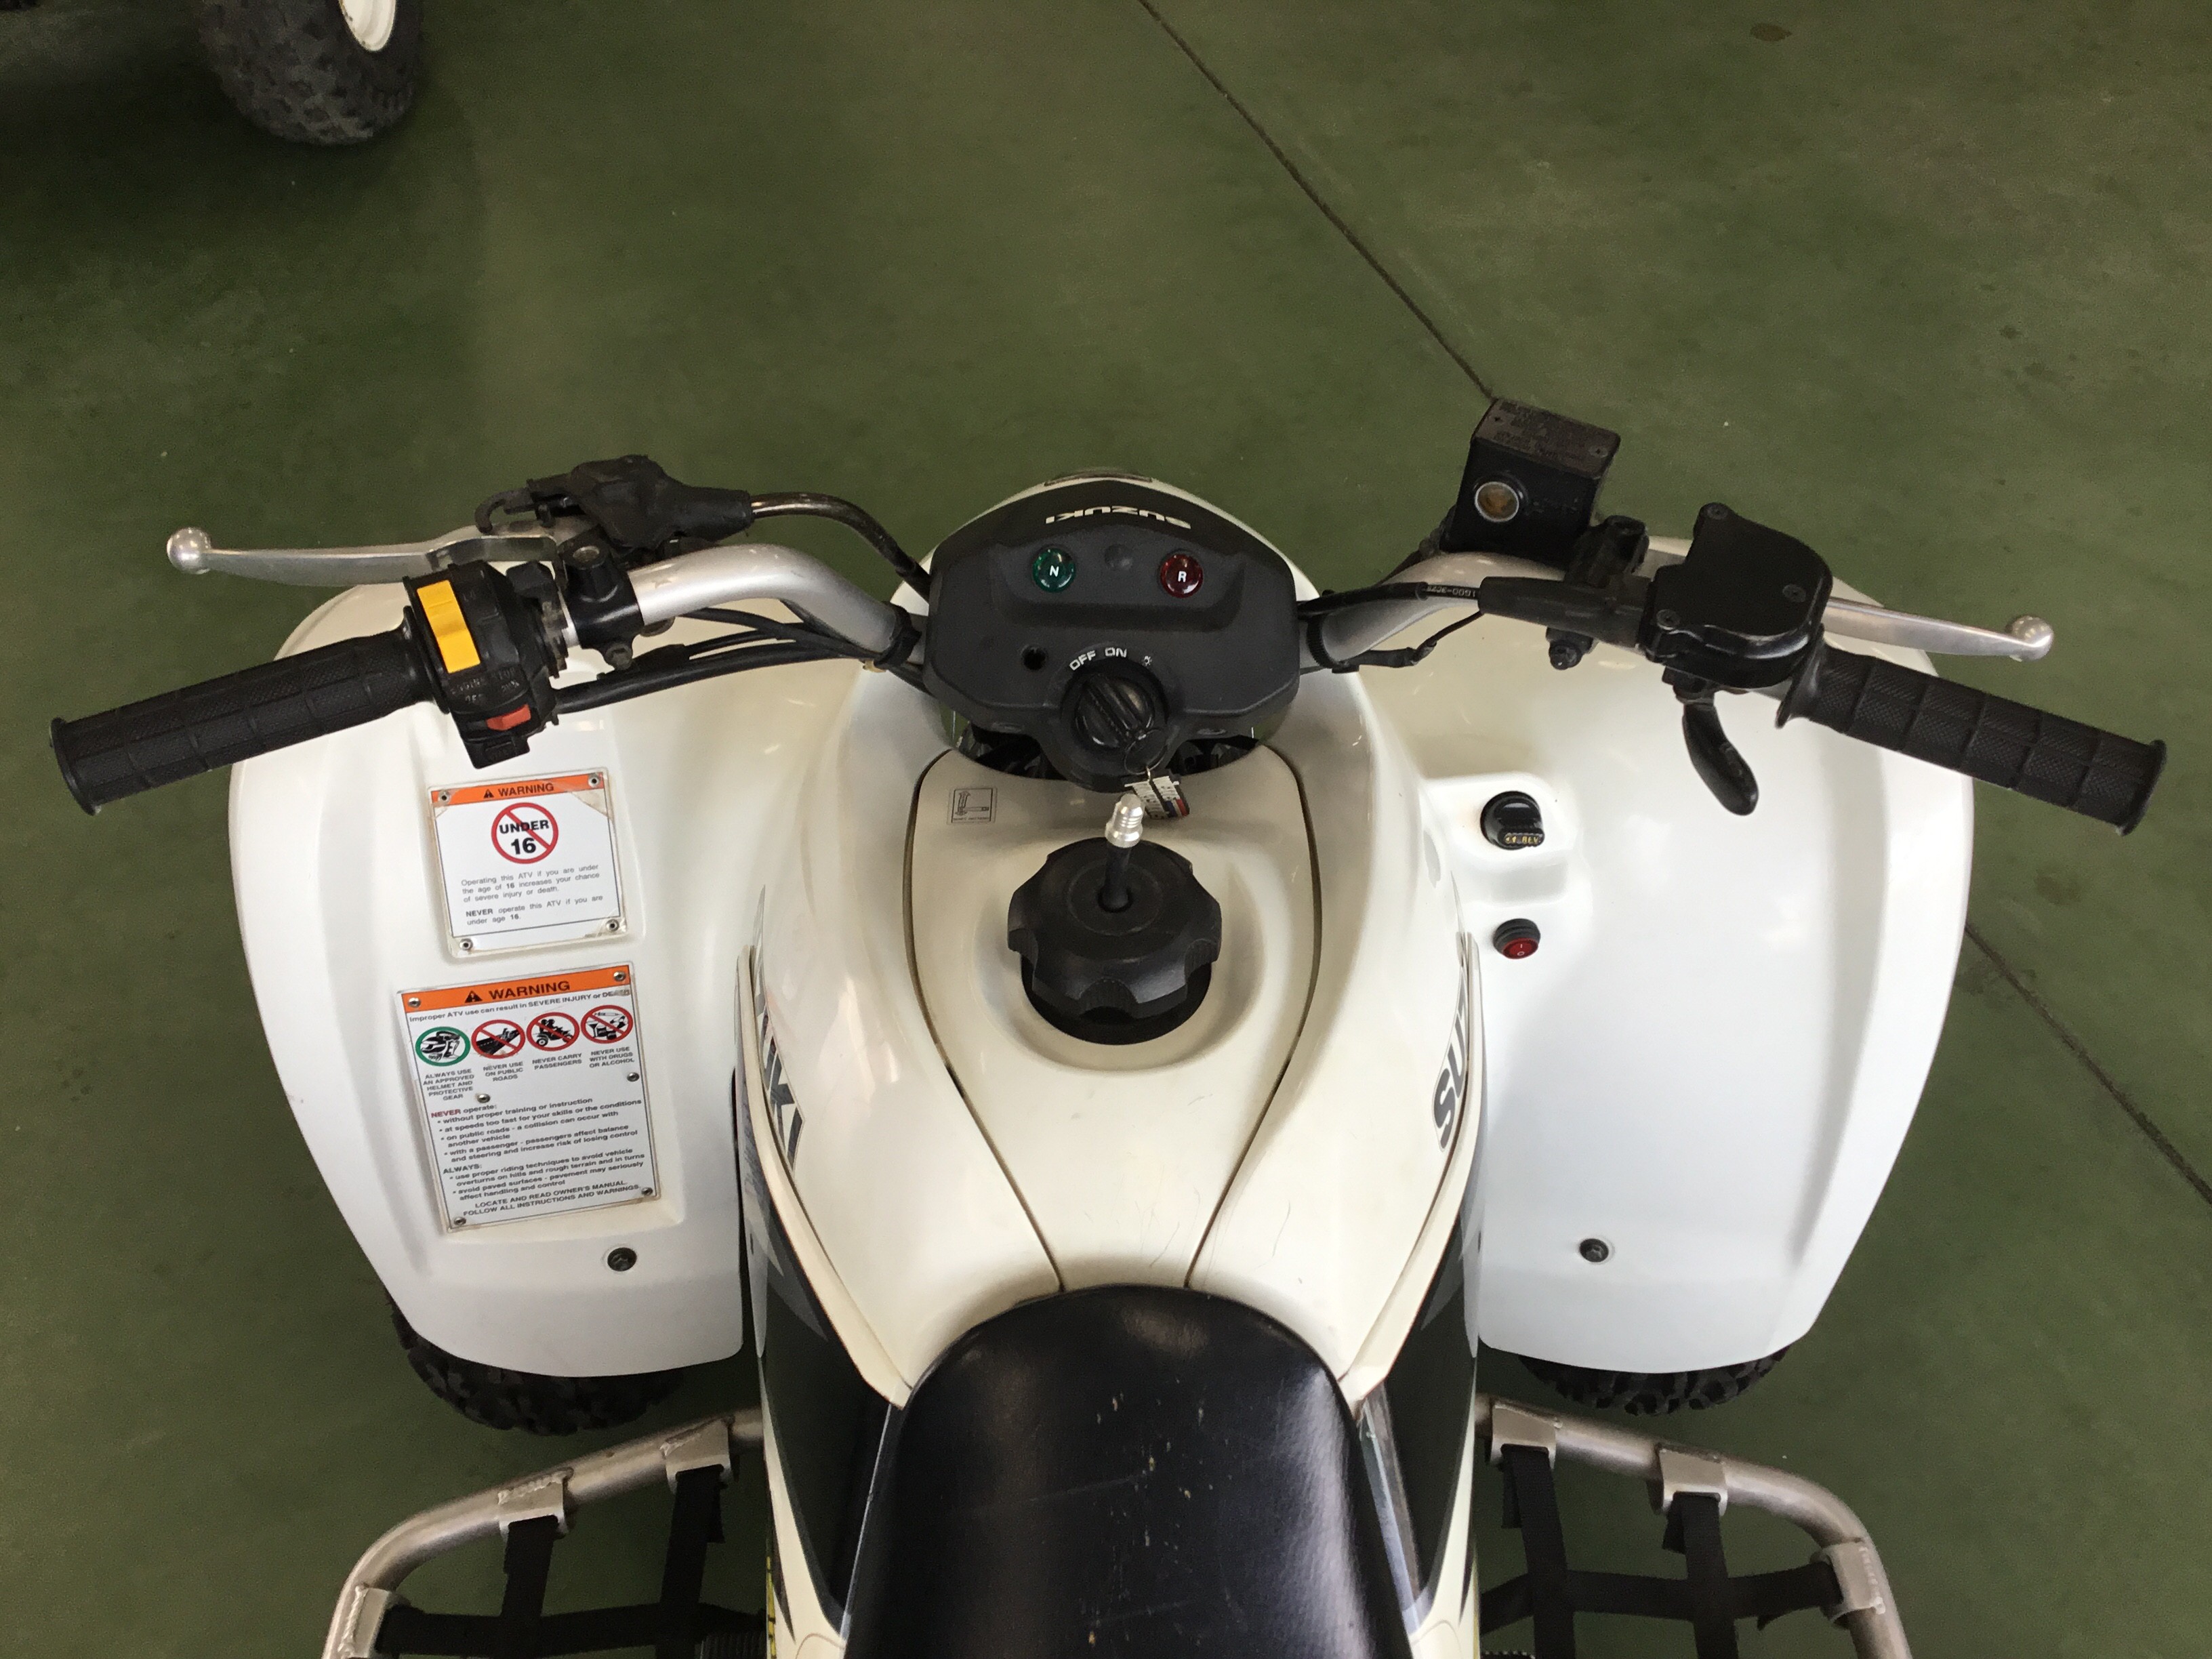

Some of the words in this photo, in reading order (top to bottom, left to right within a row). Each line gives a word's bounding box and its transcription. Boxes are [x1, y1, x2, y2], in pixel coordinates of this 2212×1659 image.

[1050, 565, 1059, 577] N
[1178, 571, 1187, 582] R
[1105, 647, 1127, 658] ON
[1069, 650, 1096, 670] OFF
[498, 783, 554, 797] WARNING
[499, 819, 550, 834] UNDER
[511, 838, 537, 855] 16
[461, 877, 497, 886] Operating
[518, 871, 533, 879] ATV
[545, 869, 559, 878] you
[578, 864, 598, 872] under
[518, 878, 552, 887] increases
[555, 876, 571, 884] your
[575, 872, 600, 880] chance
[502, 890, 522, 899] injury
[466, 908, 493, 917] NEVER
[498, 905, 525, 914] operate
[546, 899, 561, 907] ATV
[489, 981, 570, 1000] WARNING
[409, 1013, 445, 1022] Improper
[528, 998, 560, 1007] SEVERE
[562, 994, 592, 1002] INJURY
[531, 1056, 556, 1064] NEVER
[557, 1052, 582, 1061] CARRY
[590, 1048, 615, 1056] NEVER
[608, 1051, 633, 1060] DRUGS
[483, 1063, 508, 1071] NEVER
[534, 1059, 582, 1070] PASSENGERS
[601, 1057, 634, 1067] ALCOHOL
[425, 1070, 455, 1080] ALWAYS
[492, 1073, 518, 1082] ROADS
[497, 1067, 523, 1075] PUBLIC
[434, 1074, 474, 1084] APPROVED
[426, 1082, 455, 1091] HELMET
[428, 1086, 473, 1097] PROTECTIVE
[430, 1108, 462, 1118] NEVER
[443, 1114, 474, 1124] without
[476, 1111, 503, 1120] proper
[505, 1106, 537, 1115] training
[549, 1098, 593, 1108] instruction
[454, 1122, 485, 1131] speeds
[531, 1112, 550, 1121] your
[599, 1099, 642, 1109] conditions
[459, 1130, 485, 1140] public
[524, 1120, 558, 1129] collision
[577, 1113, 600, 1122] occur
[447, 1139, 479, 1147] another
[481, 1134, 510, 1143] vehicle
[468, 1151, 501, 1160] steering
[520, 1143, 554, 1151] increase
[583, 1134, 608, 1143] losing
[609, 1130, 638, 1139] control
[476, 1141, 518, 1153] passenger
[525, 1133, 572, 1145] passengers
[573, 1129, 596, 1137] affect
[598, 1125, 629, 1134] balance
[472, 1169, 499, 1178] proper
[525, 1158, 570, 1169] techniques
[581, 1152, 603, 1160] avoid
[605, 1148, 633, 1157] vehicle
[456, 1176, 495, 1187] overturns
[528, 1168, 544, 1176] and
[545, 1164, 569, 1172] rough
[570, 1160, 596, 1169] terrain
[598, 1157, 613, 1165] and
[457, 1185, 480, 1194] avoid
[482, 1181, 506, 1191] paved
[508, 1176, 542, 1186] surfaces
[549, 1169, 588, 1181] pavement
[608, 1161, 644, 1170] seriously
[459, 1193, 482, 1201] affect
[483, 1187, 519, 1197] handling
[520, 1183, 535, 1191] and
[537, 1179, 565, 1189] control
[463, 1206, 497, 1216] FOLLOW
[516, 1194, 575, 1208] INSTRUCTIONS
[577, 1191, 595, 1199] AND
[474, 1198, 508, 1208] LOCATE
[510, 1195, 527, 1203] AND
[529, 1191, 552, 1200] READ
